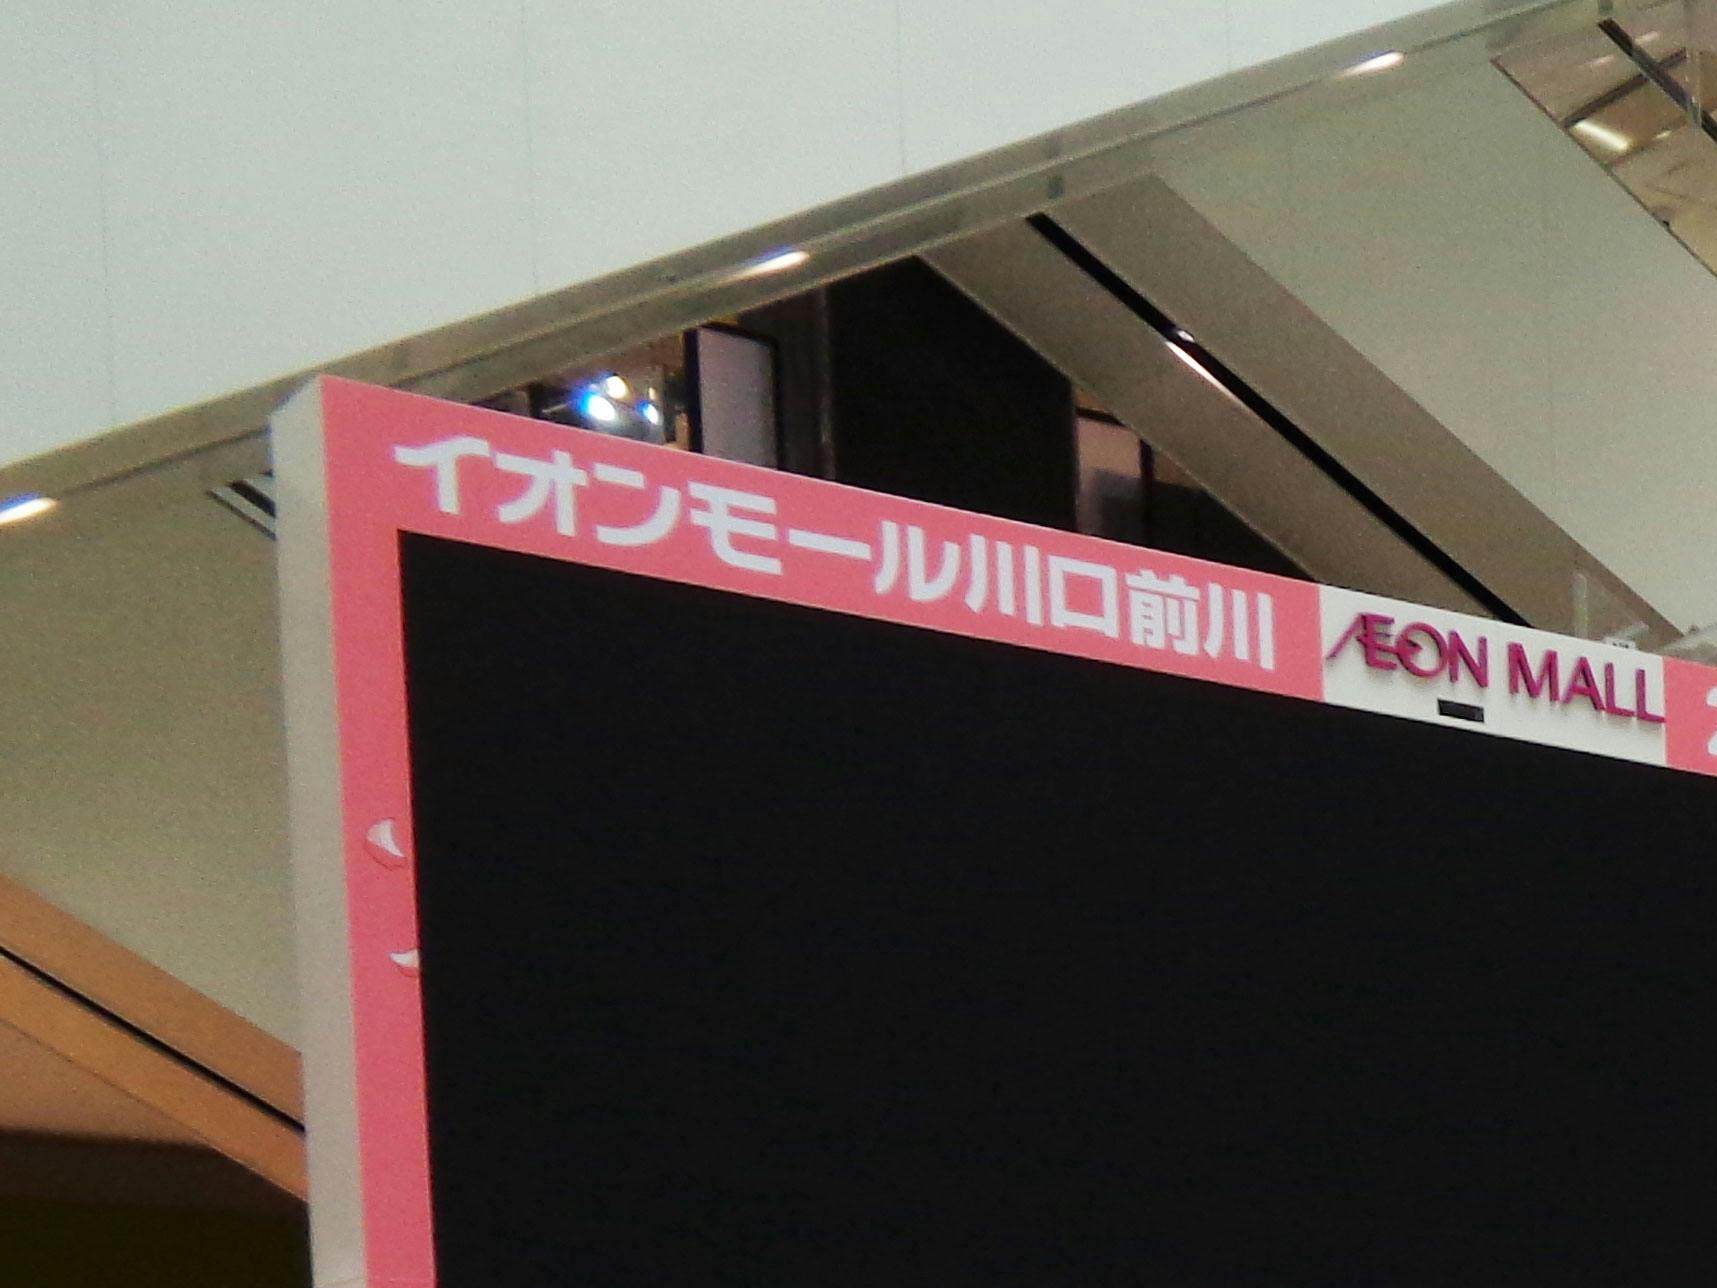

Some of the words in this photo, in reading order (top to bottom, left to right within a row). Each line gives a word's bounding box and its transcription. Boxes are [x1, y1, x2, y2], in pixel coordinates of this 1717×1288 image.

[393, 435, 1277, 670] イオンモール川口前川
[1507, 642, 1666, 723] MALL
